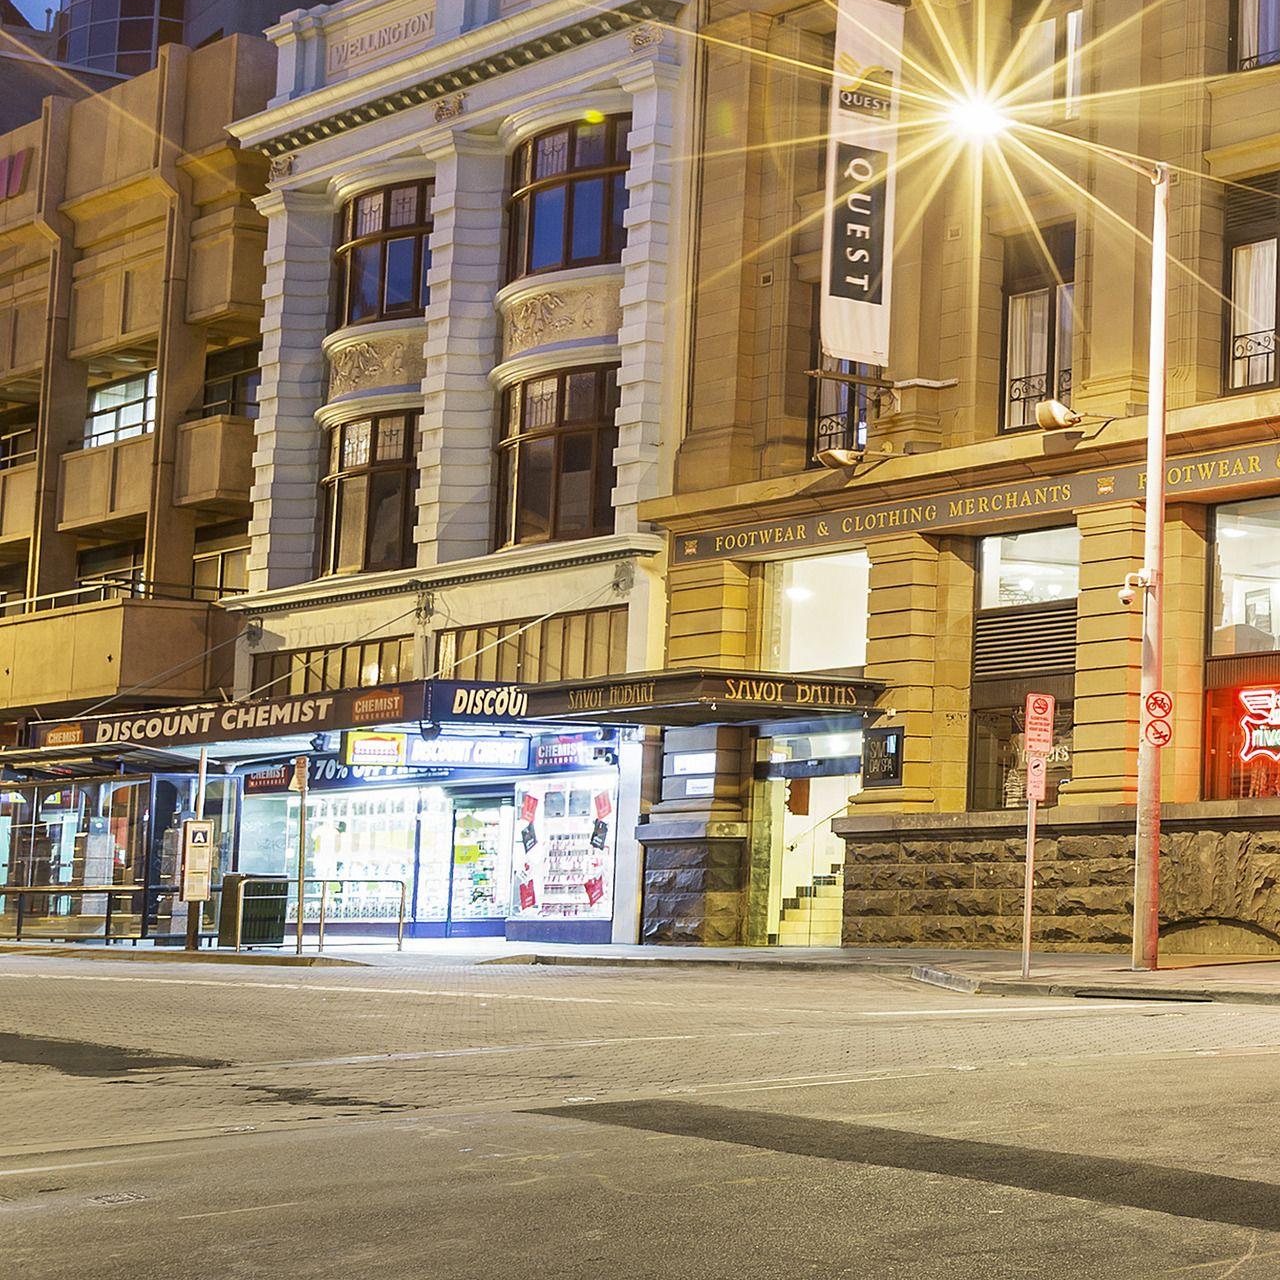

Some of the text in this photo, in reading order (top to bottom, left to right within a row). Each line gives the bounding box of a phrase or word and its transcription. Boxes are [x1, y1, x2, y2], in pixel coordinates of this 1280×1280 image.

[332, 10, 434, 65] WELLINGTON
[840, 90, 890, 114] QUEST
[843, 157, 873, 292] QUEST
[1138, 456, 1262, 491] FOTWEAR
[714, 524, 806, 552] FOOTWEAR
[817, 522, 829, 537] &
[842, 505, 937, 534] CLOTHING
[949, 484, 1072, 517] MERCHANTS
[355, 695, 400, 713] CHEMIST
[567, 680, 656, 710] SAVOY HOBART
[725, 678, 857, 706] SAVOY BATHS
[96, 698, 333, 743] DISCOUNT CHEMIST
[48, 730, 82, 743] CHEMIST
[538, 743, 578, 759] CHEMIS
[250, 767, 286, 780] CHEMIST
[314, 759, 348, 781] 70%
[193, 831, 205, 843] A
